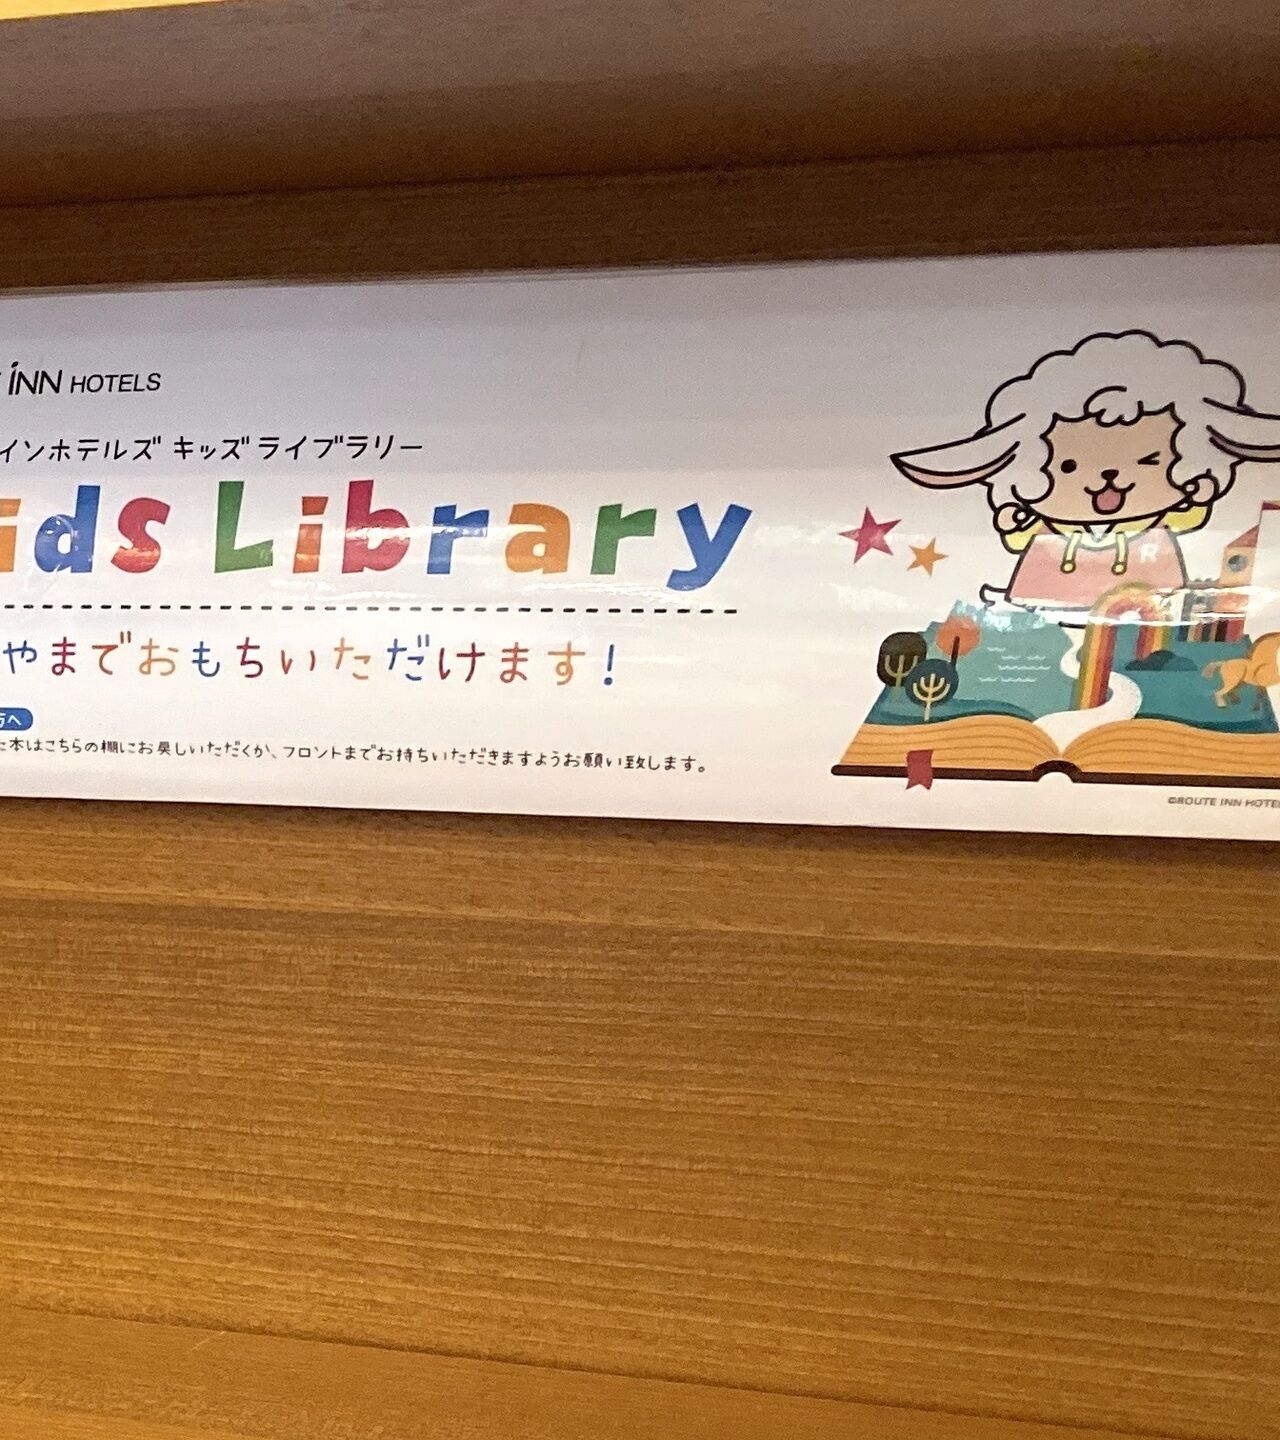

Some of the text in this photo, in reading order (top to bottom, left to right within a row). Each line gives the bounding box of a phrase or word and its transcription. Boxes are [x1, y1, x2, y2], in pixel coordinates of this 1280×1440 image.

[8, 361, 63, 397] INN
[70, 371, 162, 394] HOTELS
[173, 433, 251, 462] キッズ
[257, 433, 424, 462] ライブラリー
[212, 479, 753, 593] Library
